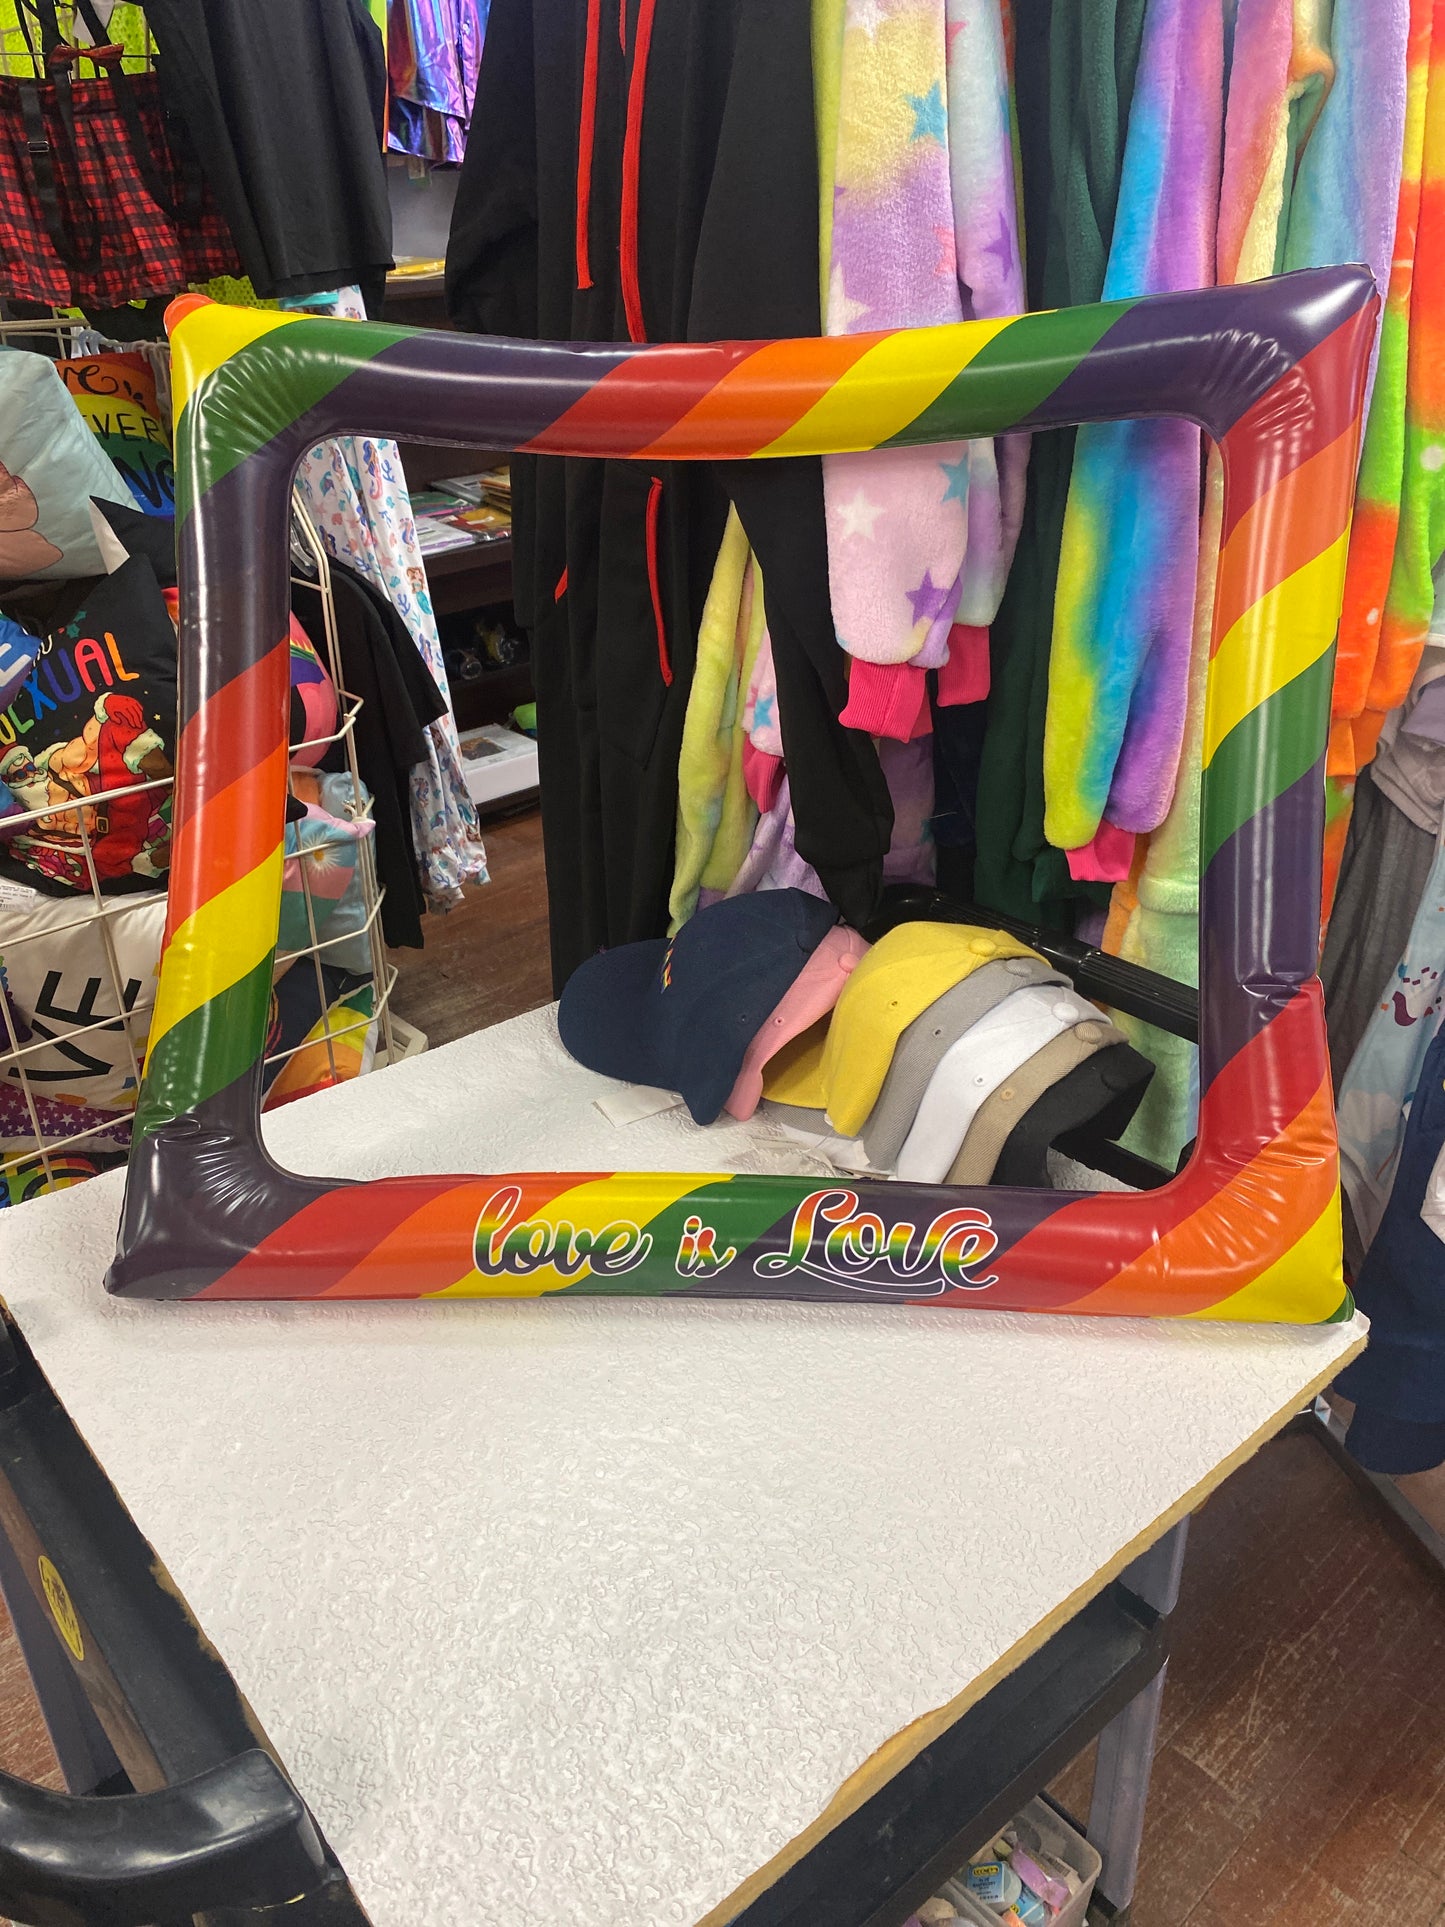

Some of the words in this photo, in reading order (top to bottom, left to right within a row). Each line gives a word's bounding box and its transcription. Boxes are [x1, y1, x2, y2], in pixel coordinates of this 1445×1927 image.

[472, 1185, 651, 1277] love
[675, 1216, 737, 1278] is
[752, 1187, 999, 1296] Love
